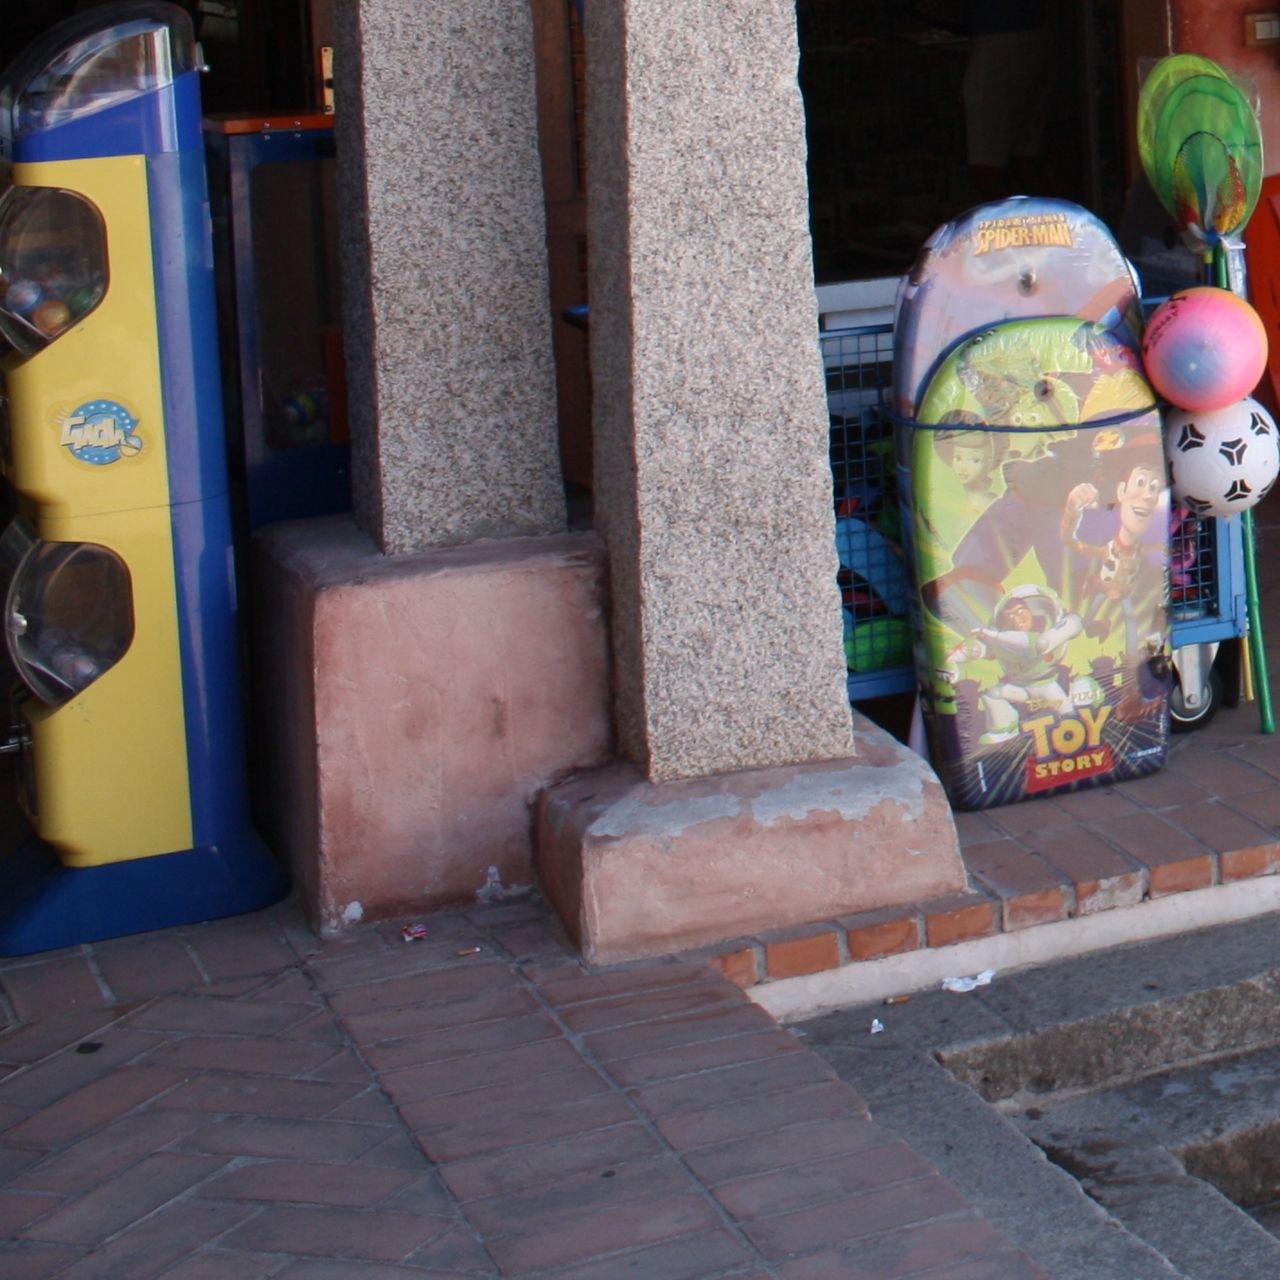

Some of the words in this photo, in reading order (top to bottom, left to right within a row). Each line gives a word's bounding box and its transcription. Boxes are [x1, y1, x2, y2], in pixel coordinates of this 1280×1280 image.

[973, 223, 1073, 256] SPIDER-MAN
[1022, 705, 1112, 758] TOY
[1035, 751, 1106, 778] STORY
